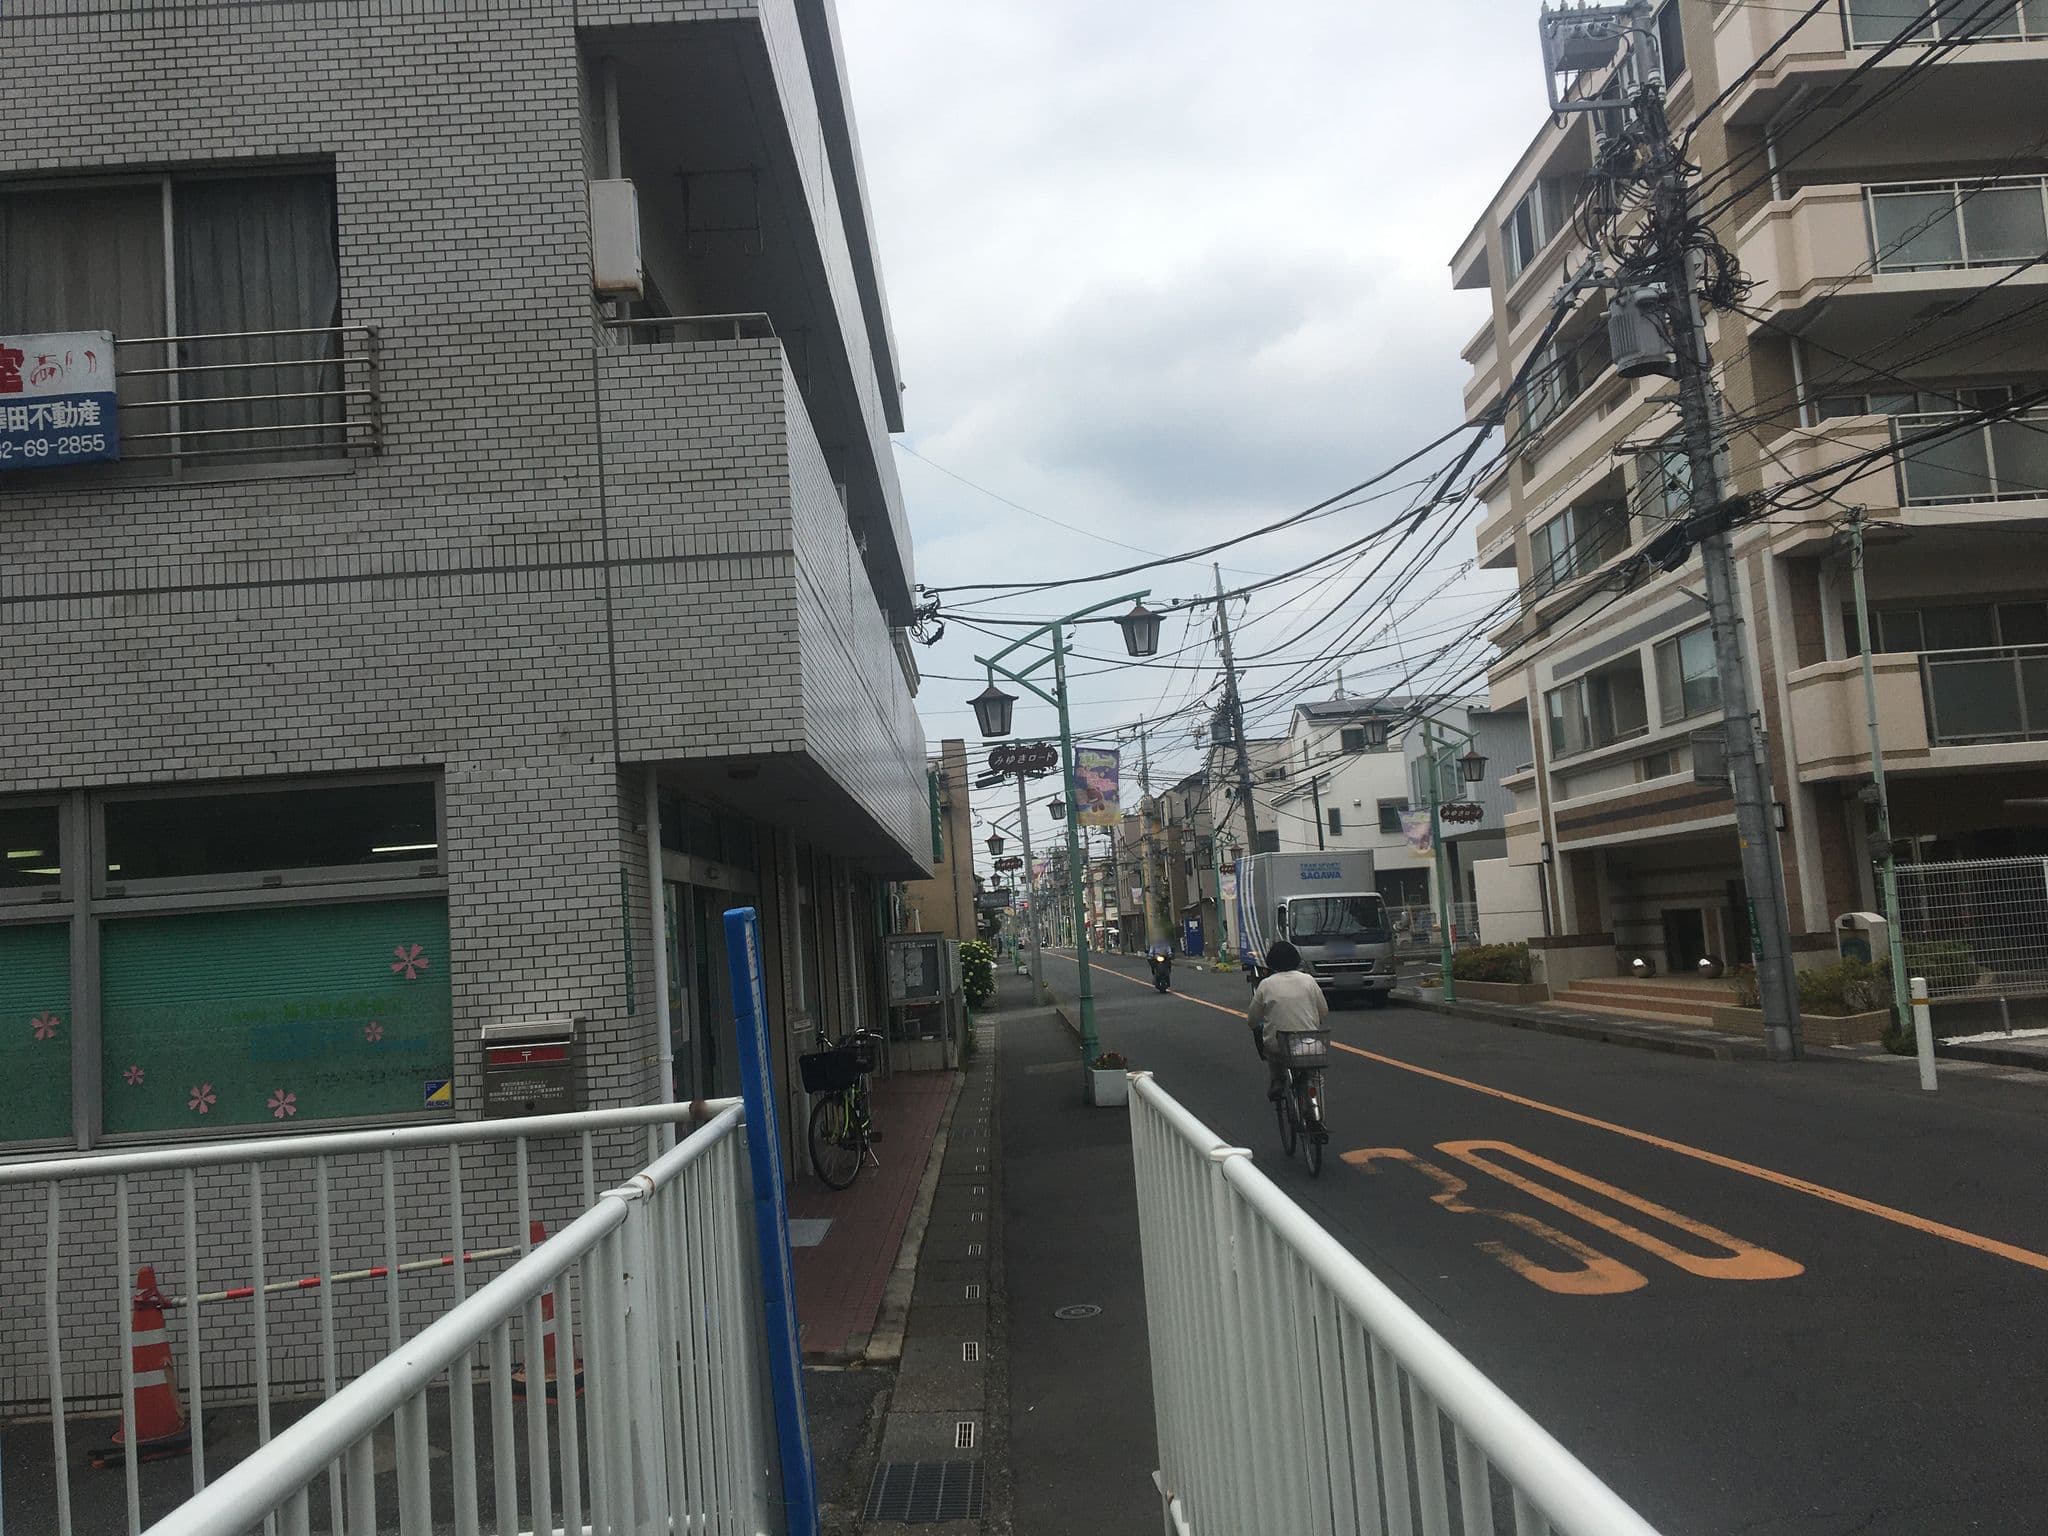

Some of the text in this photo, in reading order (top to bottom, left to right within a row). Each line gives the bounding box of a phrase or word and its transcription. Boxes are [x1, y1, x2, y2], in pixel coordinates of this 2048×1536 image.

[994, 751, 1054, 766] みゆきロード
[1300, 872, 1342, 880] SAGAWA
